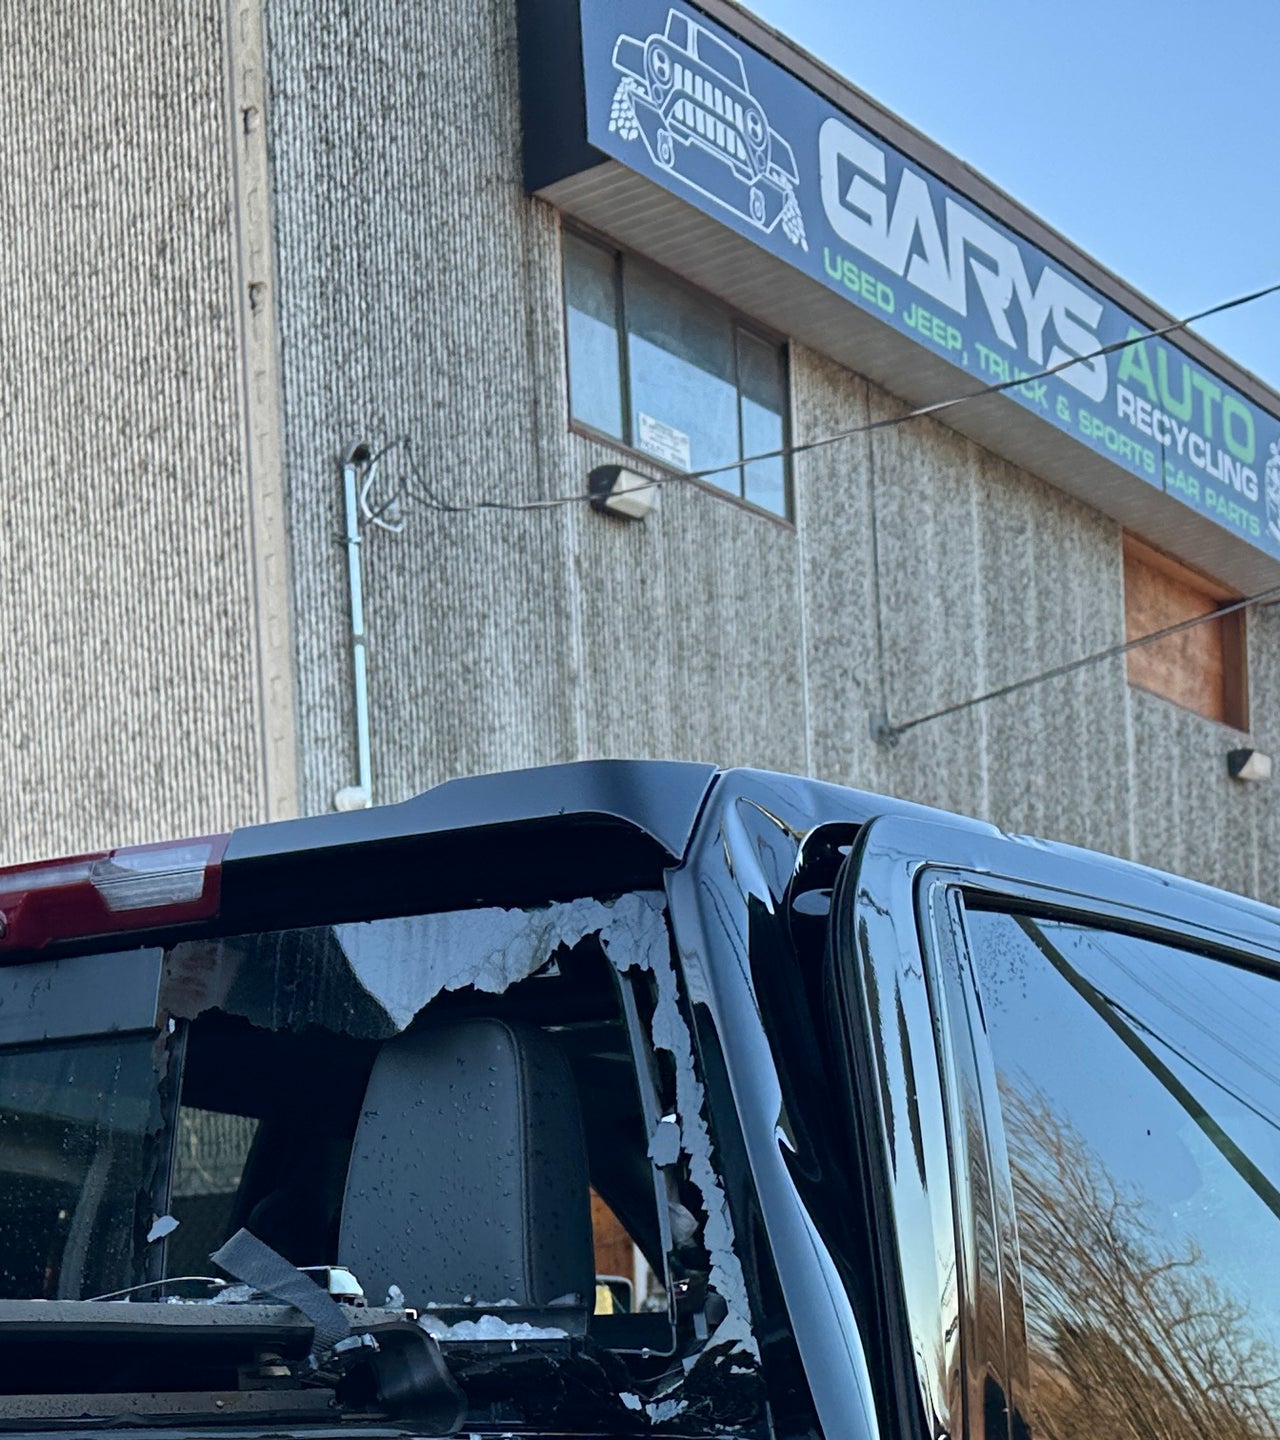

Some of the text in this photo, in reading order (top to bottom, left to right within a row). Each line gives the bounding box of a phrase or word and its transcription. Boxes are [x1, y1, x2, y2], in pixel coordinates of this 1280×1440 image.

[818, 117, 1108, 403] GARYS
[823, 247, 1261, 537] USED JEEP, TRUCK & SPORTS CAR PARTS
[1117, 326, 1256, 466] AUTO
[1117, 384, 1259, 502] RECYCLING
